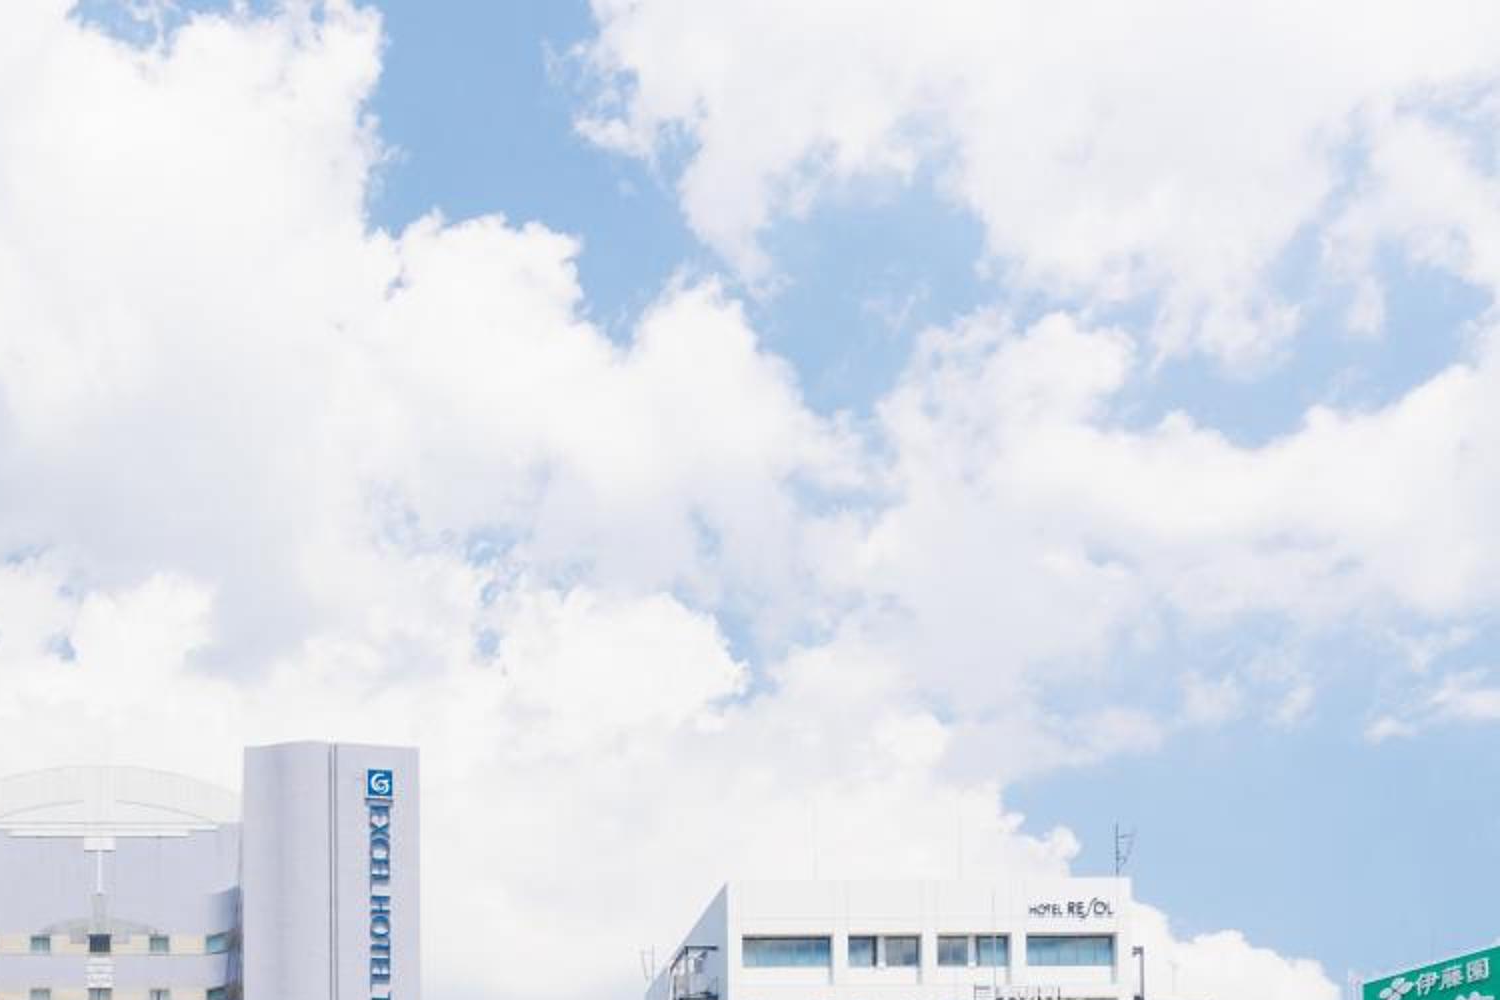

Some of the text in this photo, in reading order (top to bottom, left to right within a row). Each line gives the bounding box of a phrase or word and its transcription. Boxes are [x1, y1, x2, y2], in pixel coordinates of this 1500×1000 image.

[369, 804, 391, 892] EXCEL
[1029, 903, 1063, 916] HOTEL
[369, 894, 391, 991] HOTEL
[1415, 957, 1490, 997] 伊藤園
